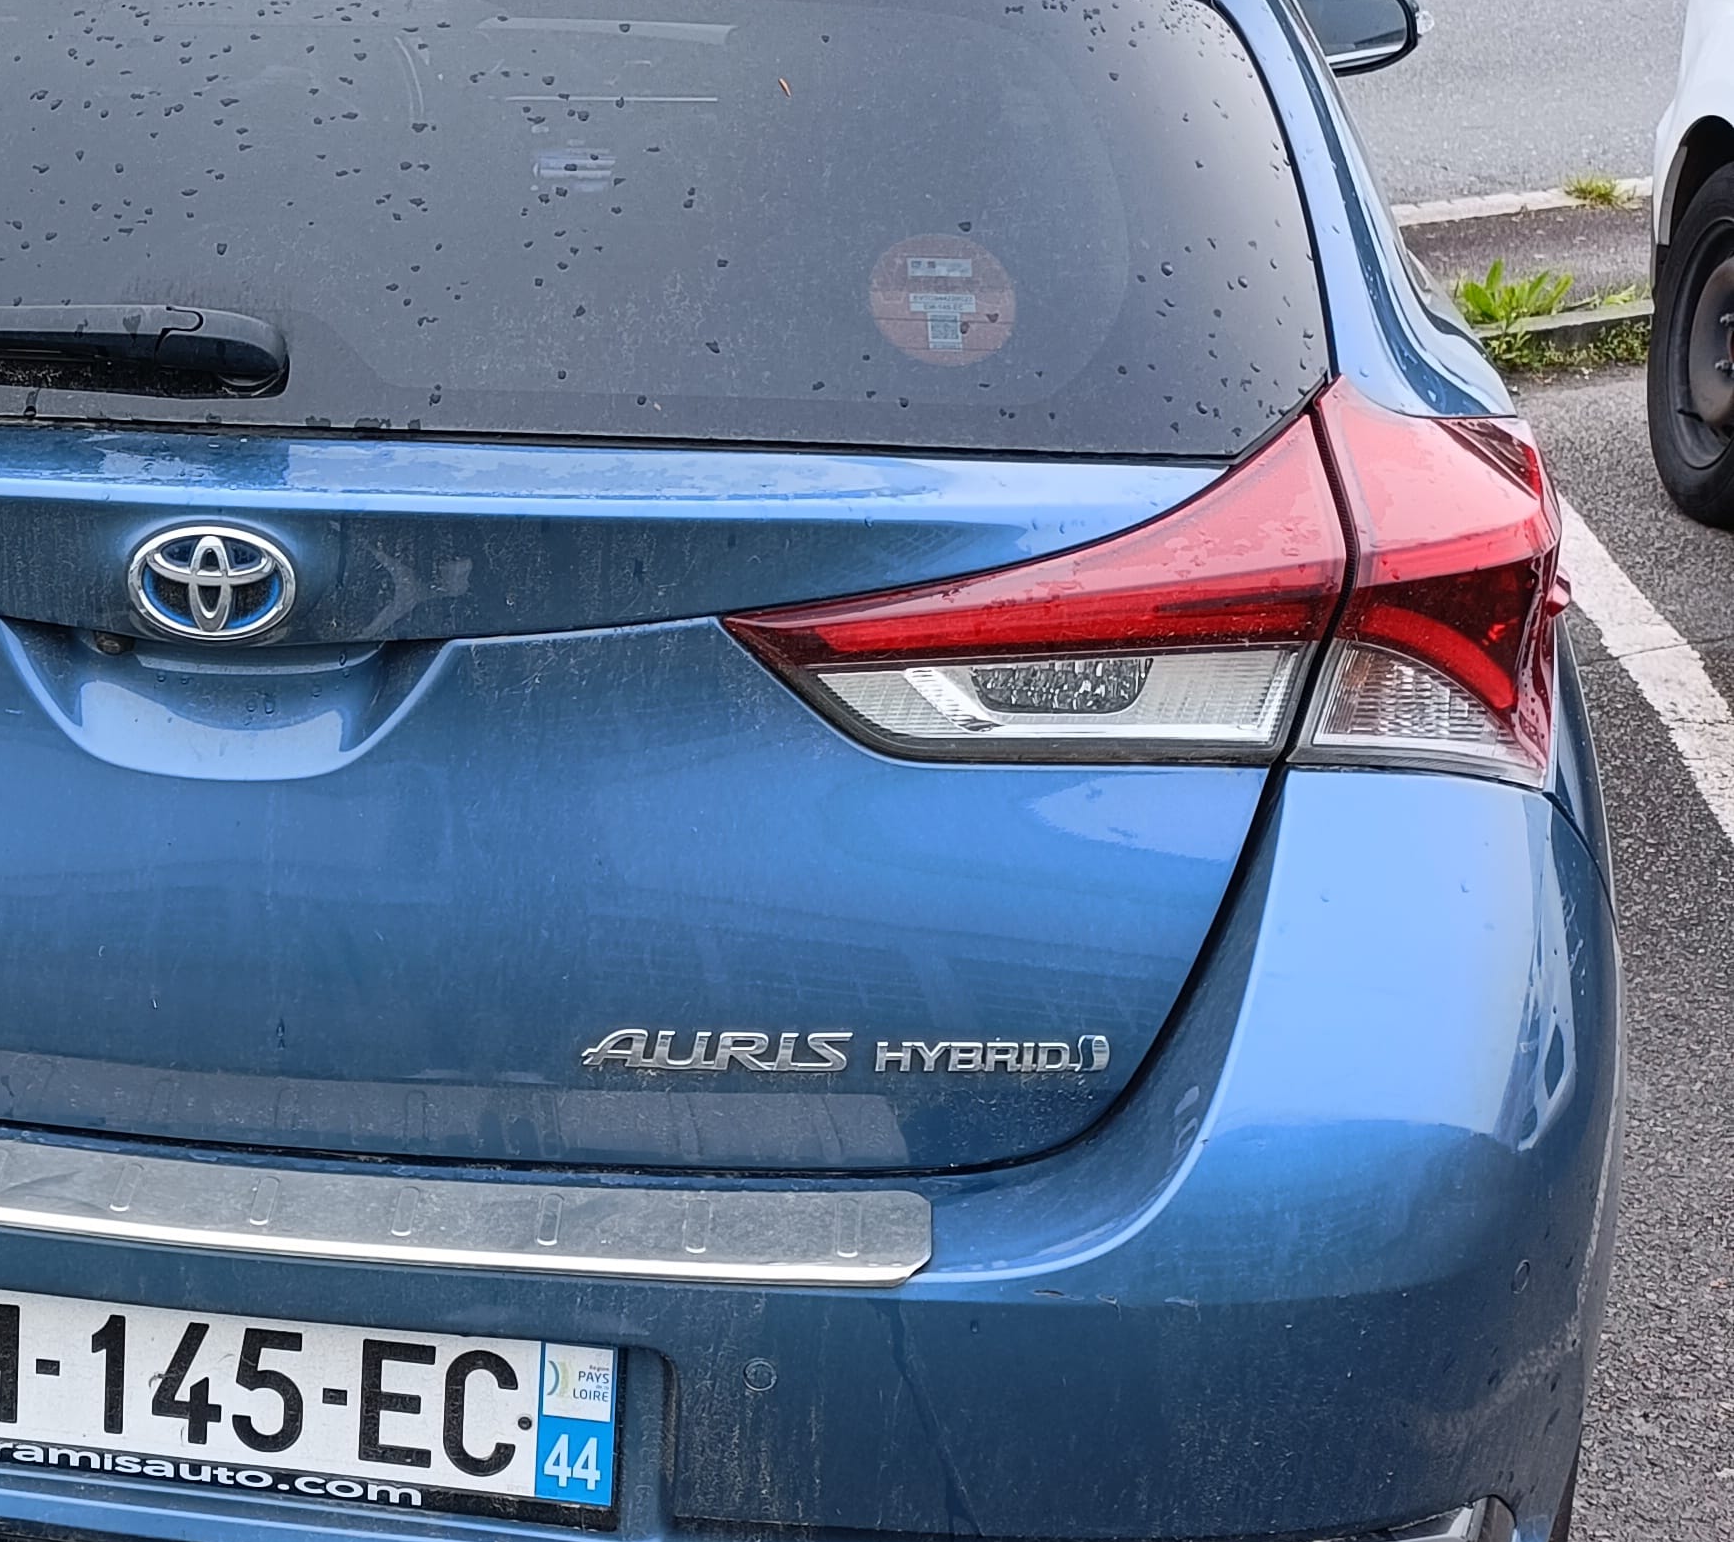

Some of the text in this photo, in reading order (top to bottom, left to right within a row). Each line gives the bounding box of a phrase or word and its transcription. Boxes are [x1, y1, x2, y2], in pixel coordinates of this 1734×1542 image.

[581, 1028, 1071, 1072] AURIS HYBRID
[578, 1370, 610, 1384] PAYS
[573, 1387, 609, 1402] LOIRE
[544, 1433, 601, 1491] 44
